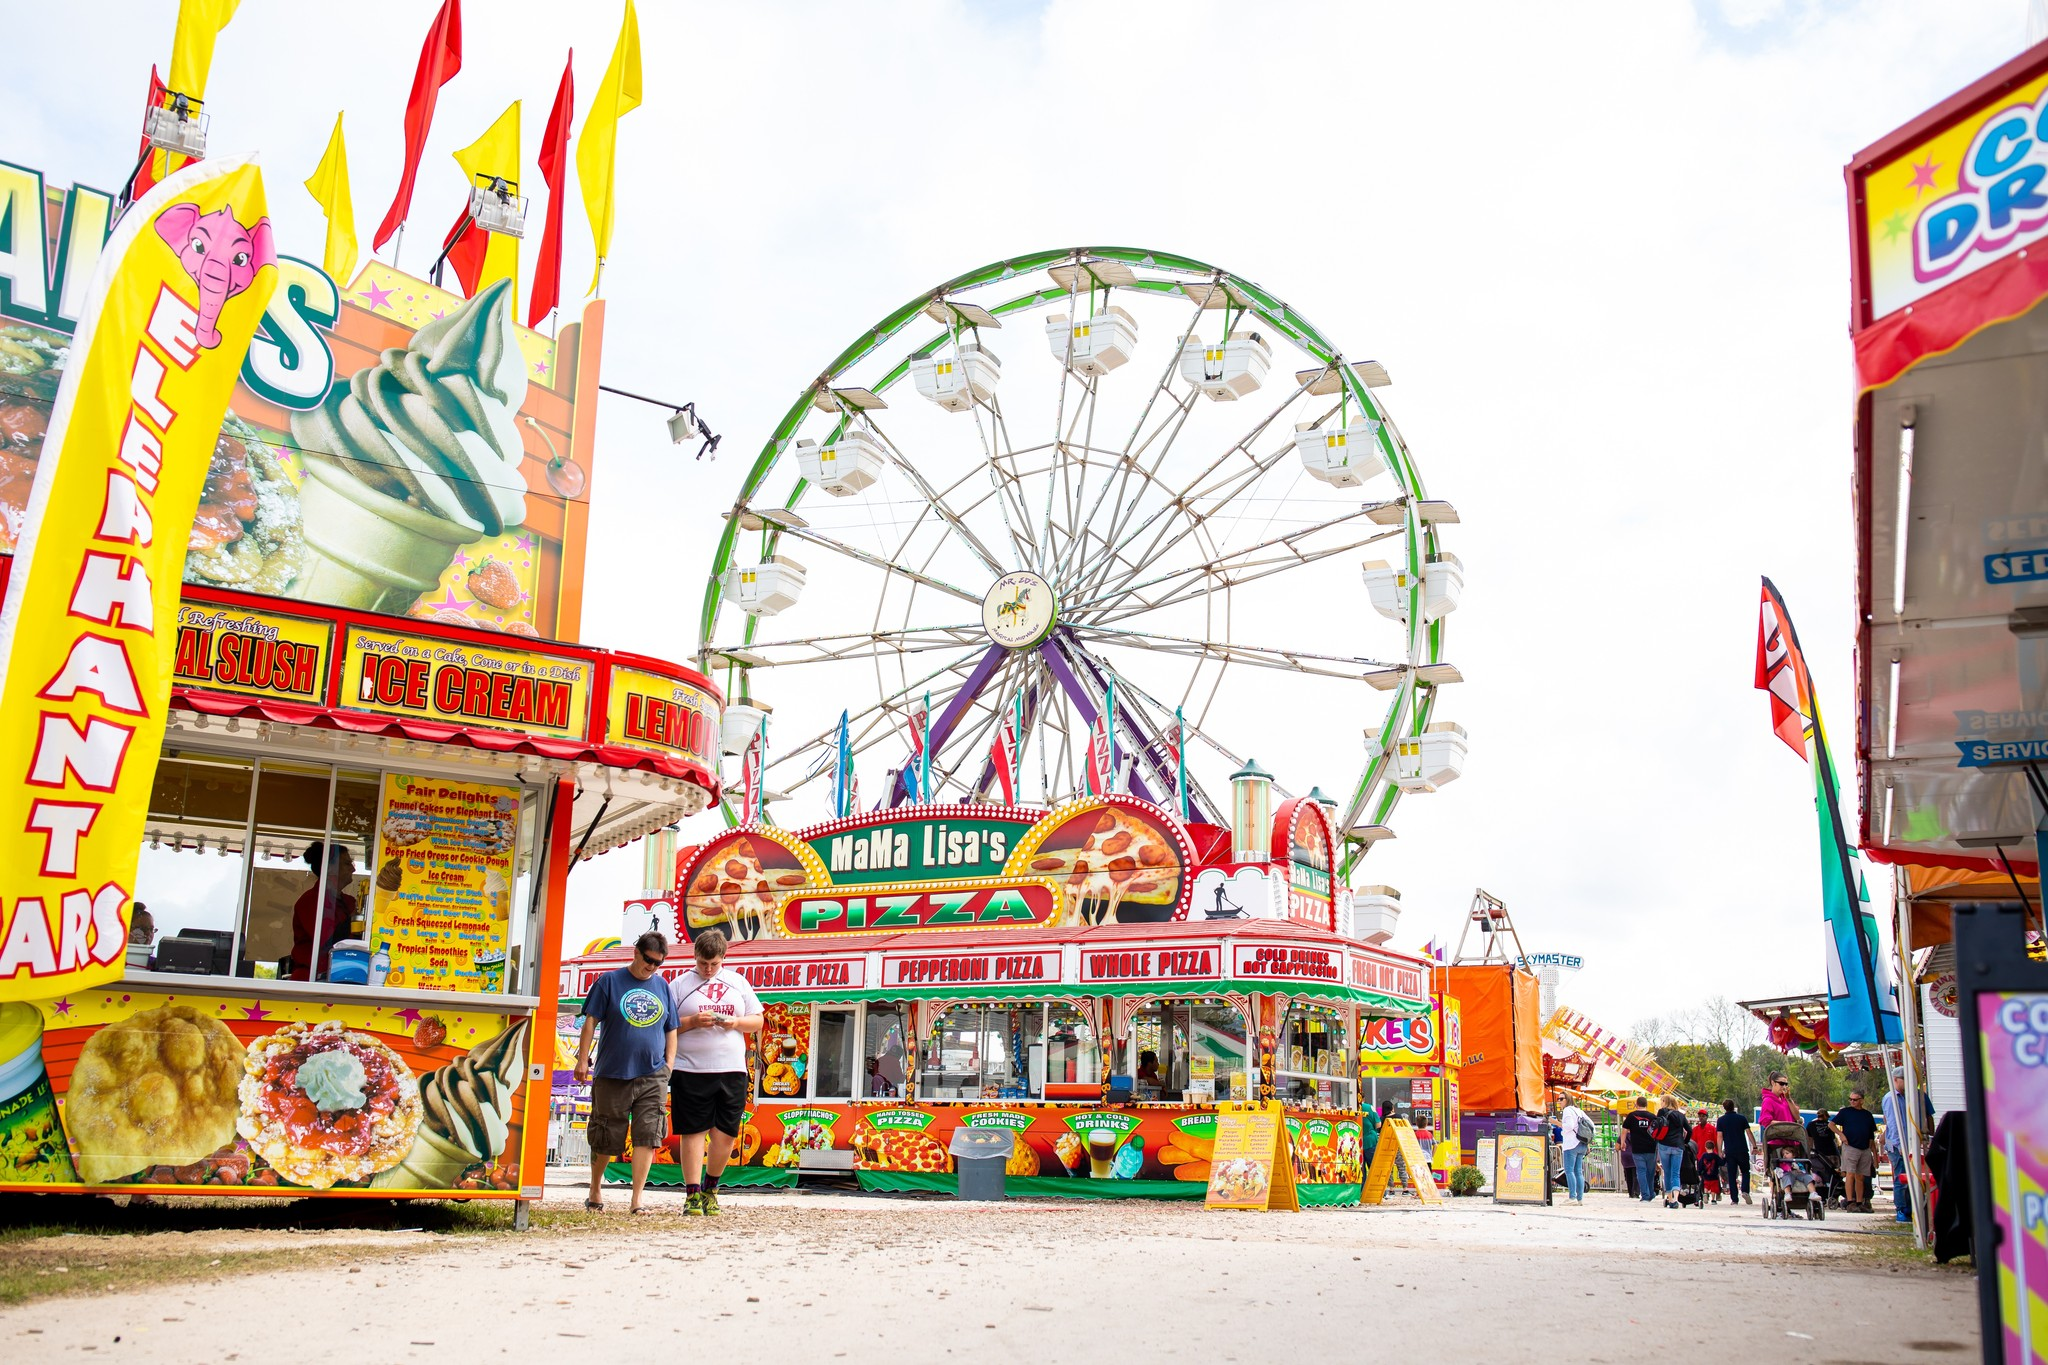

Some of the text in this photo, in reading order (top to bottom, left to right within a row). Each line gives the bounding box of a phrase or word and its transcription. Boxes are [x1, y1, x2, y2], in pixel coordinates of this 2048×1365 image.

[188, 611, 278, 641] Refreshing
[215, 632, 319, 696] SLUSH
[356, 636, 580, 681] Served on a Cake, Cone or in a Dish
[359, 652, 572, 729] ICE CREAM
[672, 688, 698, 707] Fresh
[407, 785, 498, 804] Fair Delights
[390, 799, 512, 820] Funnel Cakes or Elephant Ears
[385, 847, 509, 868] Deep Fried Oreos or Cookie Dough
[831, 824, 1006, 873] MaMa Lisa's
[428, 870, 464, 882] Ice Cream
[1290, 863, 1310, 887] MaMa
[800, 890, 1036, 931] PIZZA
[1290, 894, 1331, 926] PIZZA
[0, 881, 130, 979] ARS
[393, 915, 490, 932] Fresh Squeezed Lemonade
[397, 943, 428, 955] Tropical
[429, 945, 468, 957] Smoothies
[1256, 948, 1330, 966] COLD DRINKS
[430, 957, 449, 968] Soda
[898, 955, 1044, 983] PEPPERONI PIZZA
[1090, 950, 1212, 978] WHOLE PIZZA
[1517, 953, 1581, 967] SKYMASTER
[806, 963, 850, 985] PIZZA
[1243, 961, 1338, 979] HOT CAPPUCCINO
[1352, 959, 1419, 996] FRESH HOT PIZZA
[788, 1006, 810, 1014] PIZZA
[1361, 1017, 1429, 1049] KE'S
[783, 1110, 807, 1120] SLOPPY
[877, 1117, 923, 1127] PIZZA
[898, 1110, 925, 1119] TOSSED
[971, 1112, 1026, 1121] FRESH MADE
[971, 1118, 1026, 1128] COOKIES
[1075, 1113, 1096, 1121] HOT
[1106, 1114, 1130, 1122] COLD
[1181, 1115, 1212, 1127] BREAD
[1076, 1121, 1129, 1131] DRINKS
[1310, 1125, 1328, 1135] PIZZA
